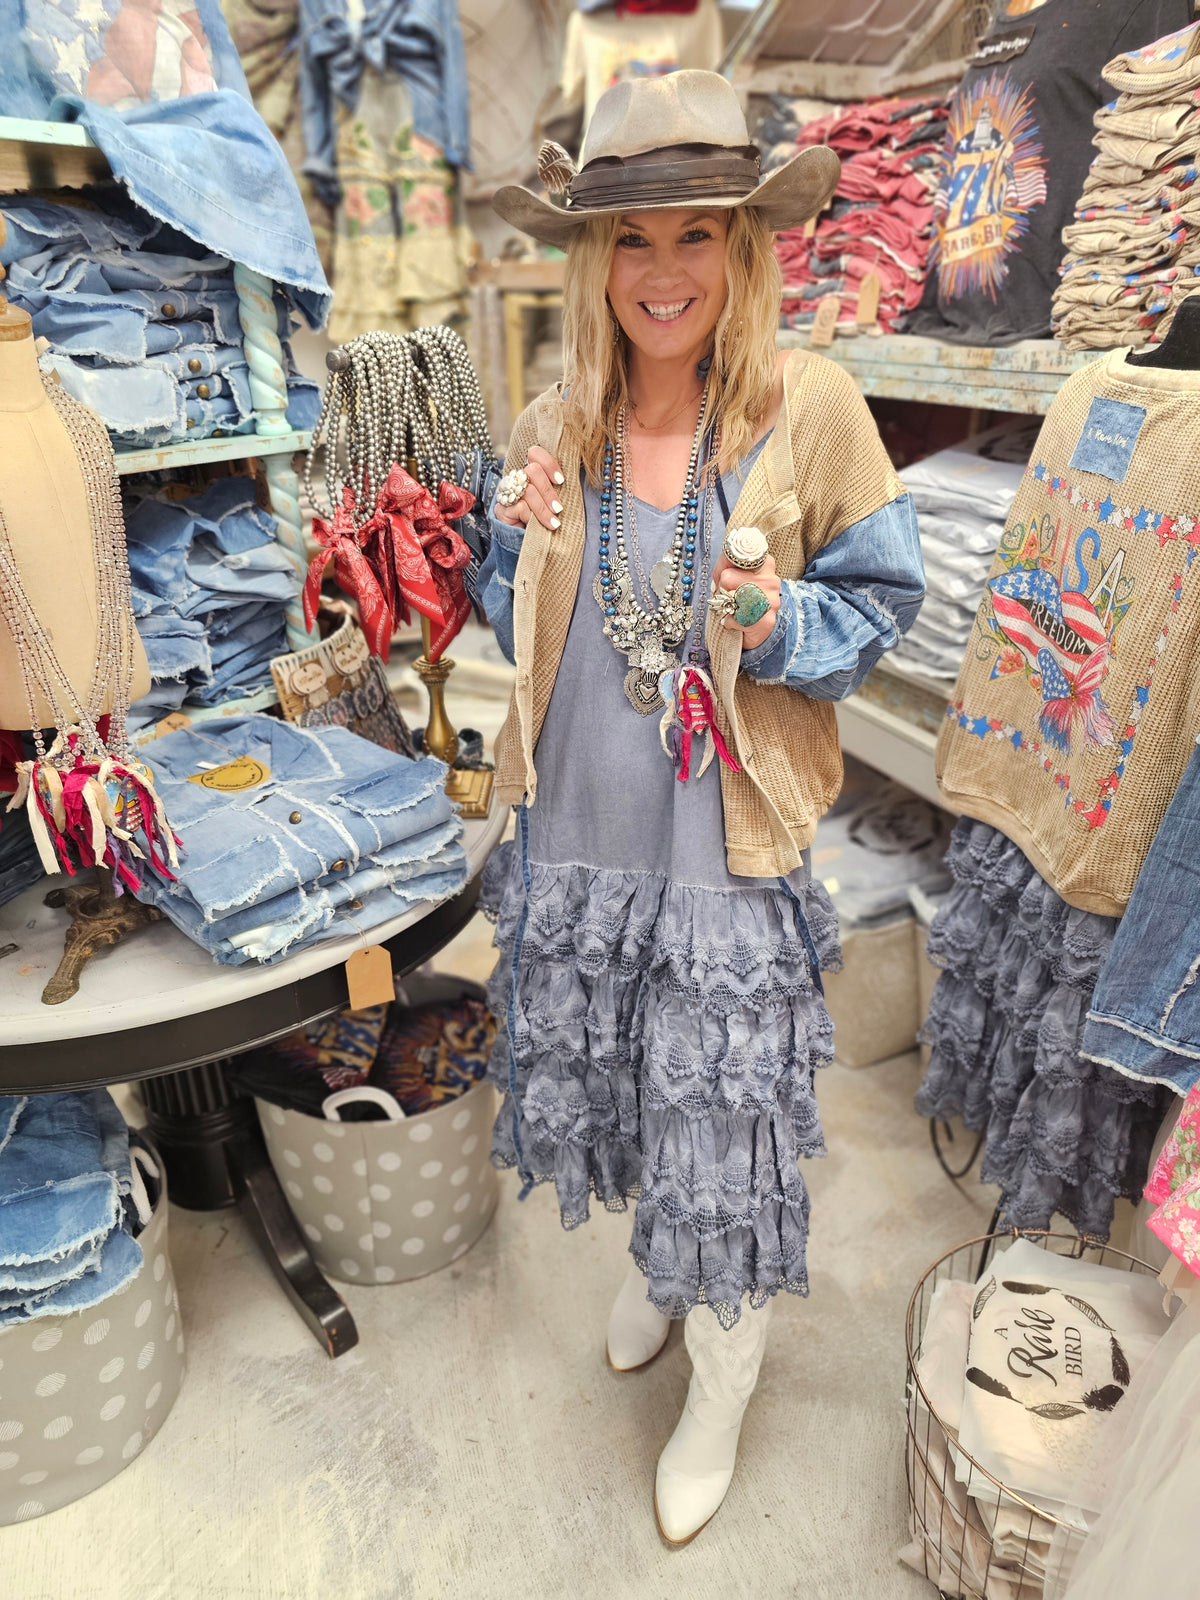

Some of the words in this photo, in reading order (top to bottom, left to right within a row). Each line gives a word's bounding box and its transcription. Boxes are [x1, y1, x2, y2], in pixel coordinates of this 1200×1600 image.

[1051, 517, 1126, 627] USA
[1030, 602, 1087, 655] FREEDOM
[994, 1327, 1008, 1340] A
[1007, 1307, 1058, 1387] Rare
[1064, 1326, 1083, 1377] BIRD
